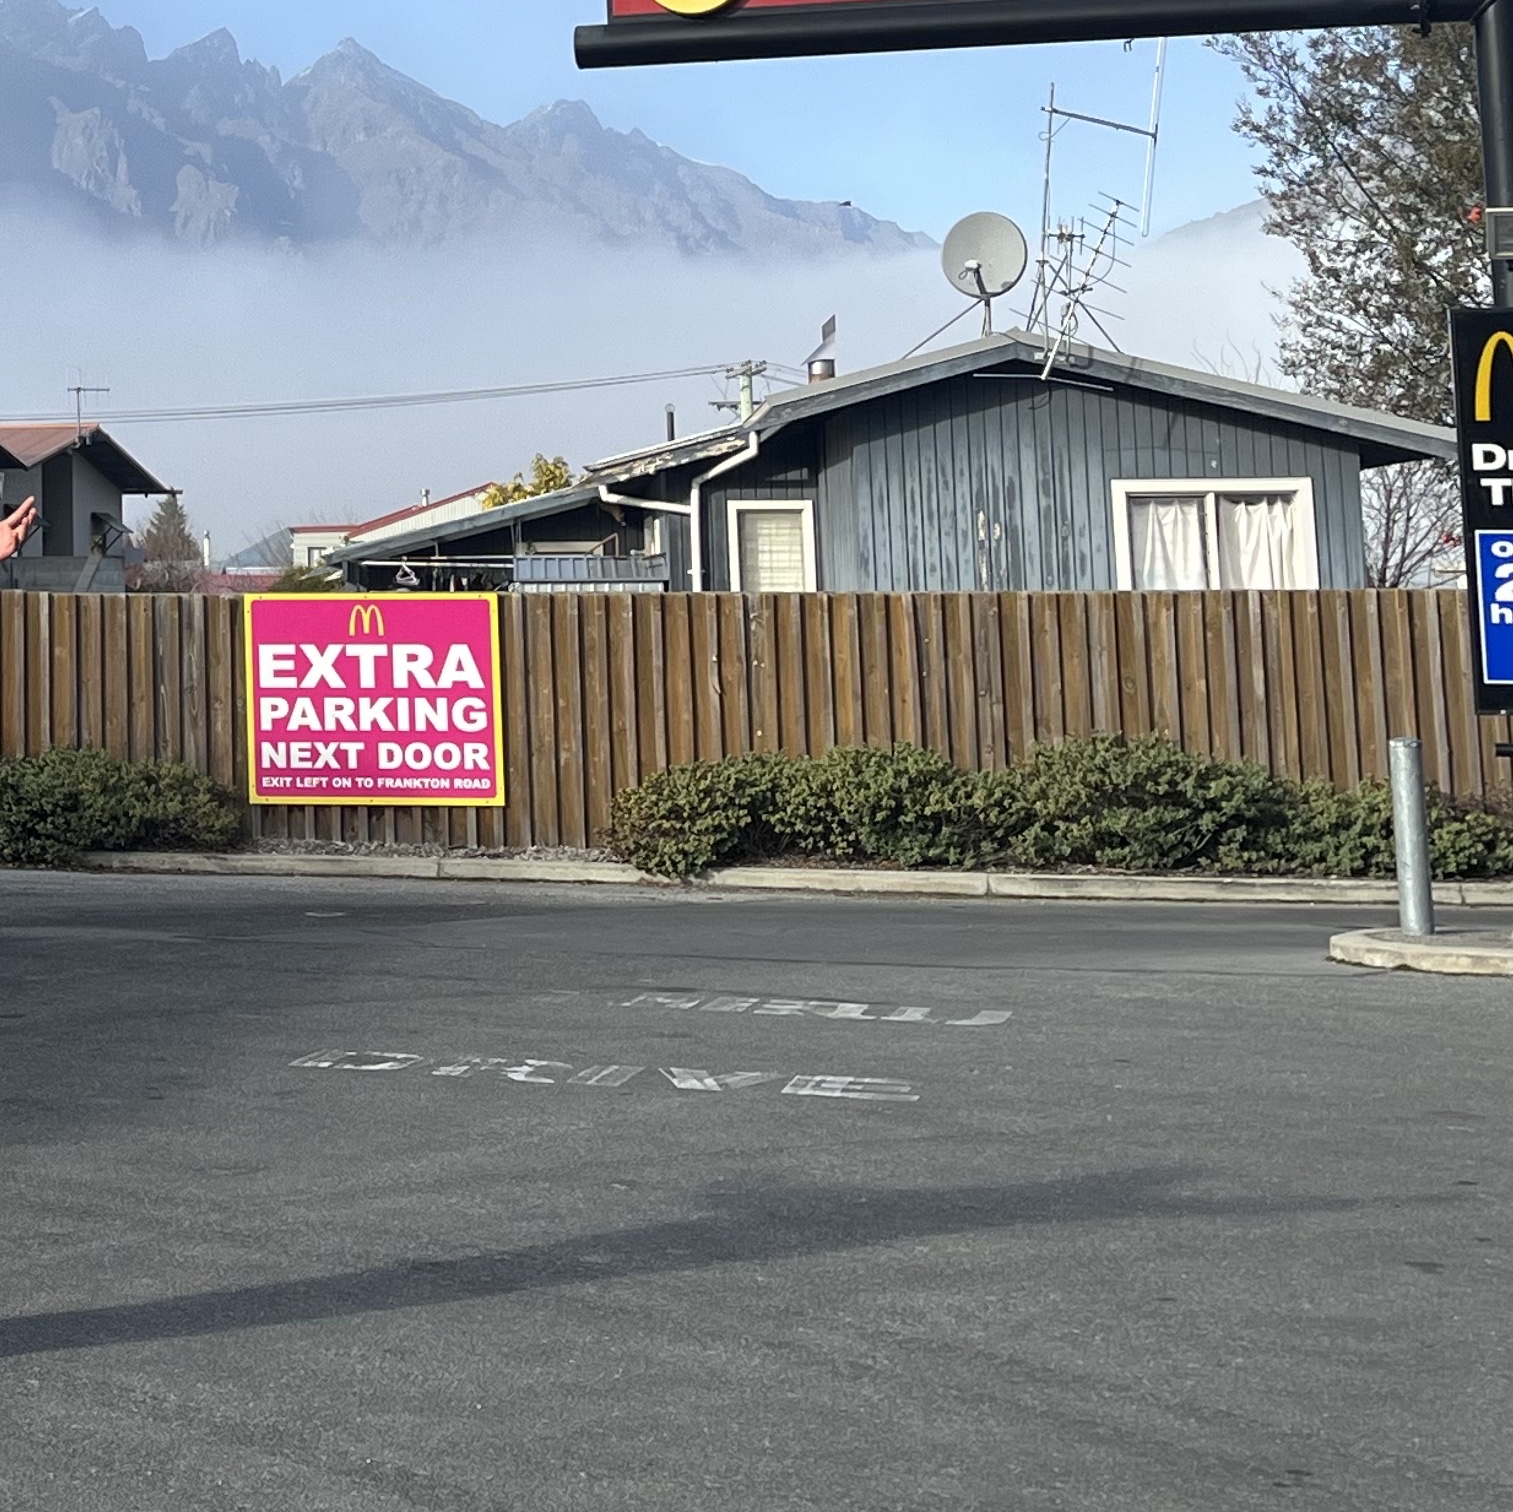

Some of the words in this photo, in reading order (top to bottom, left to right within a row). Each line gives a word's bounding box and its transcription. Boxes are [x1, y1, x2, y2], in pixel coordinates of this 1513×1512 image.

[258, 643, 486, 689] EXTRA
[259, 696, 488, 733] PARKING
[261, 741, 365, 769] NEXT
[377, 742, 491, 771] DOOR
[262, 776, 293, 788] EXIT
[295, 776, 328, 788] LEFT
[332, 777, 352, 788] ON
[355, 777, 374, 789] TO
[377, 777, 450, 789] FRANKTON
[453, 778, 491, 790] ROAD
[288, 1048, 921, 1102] DRIVE
